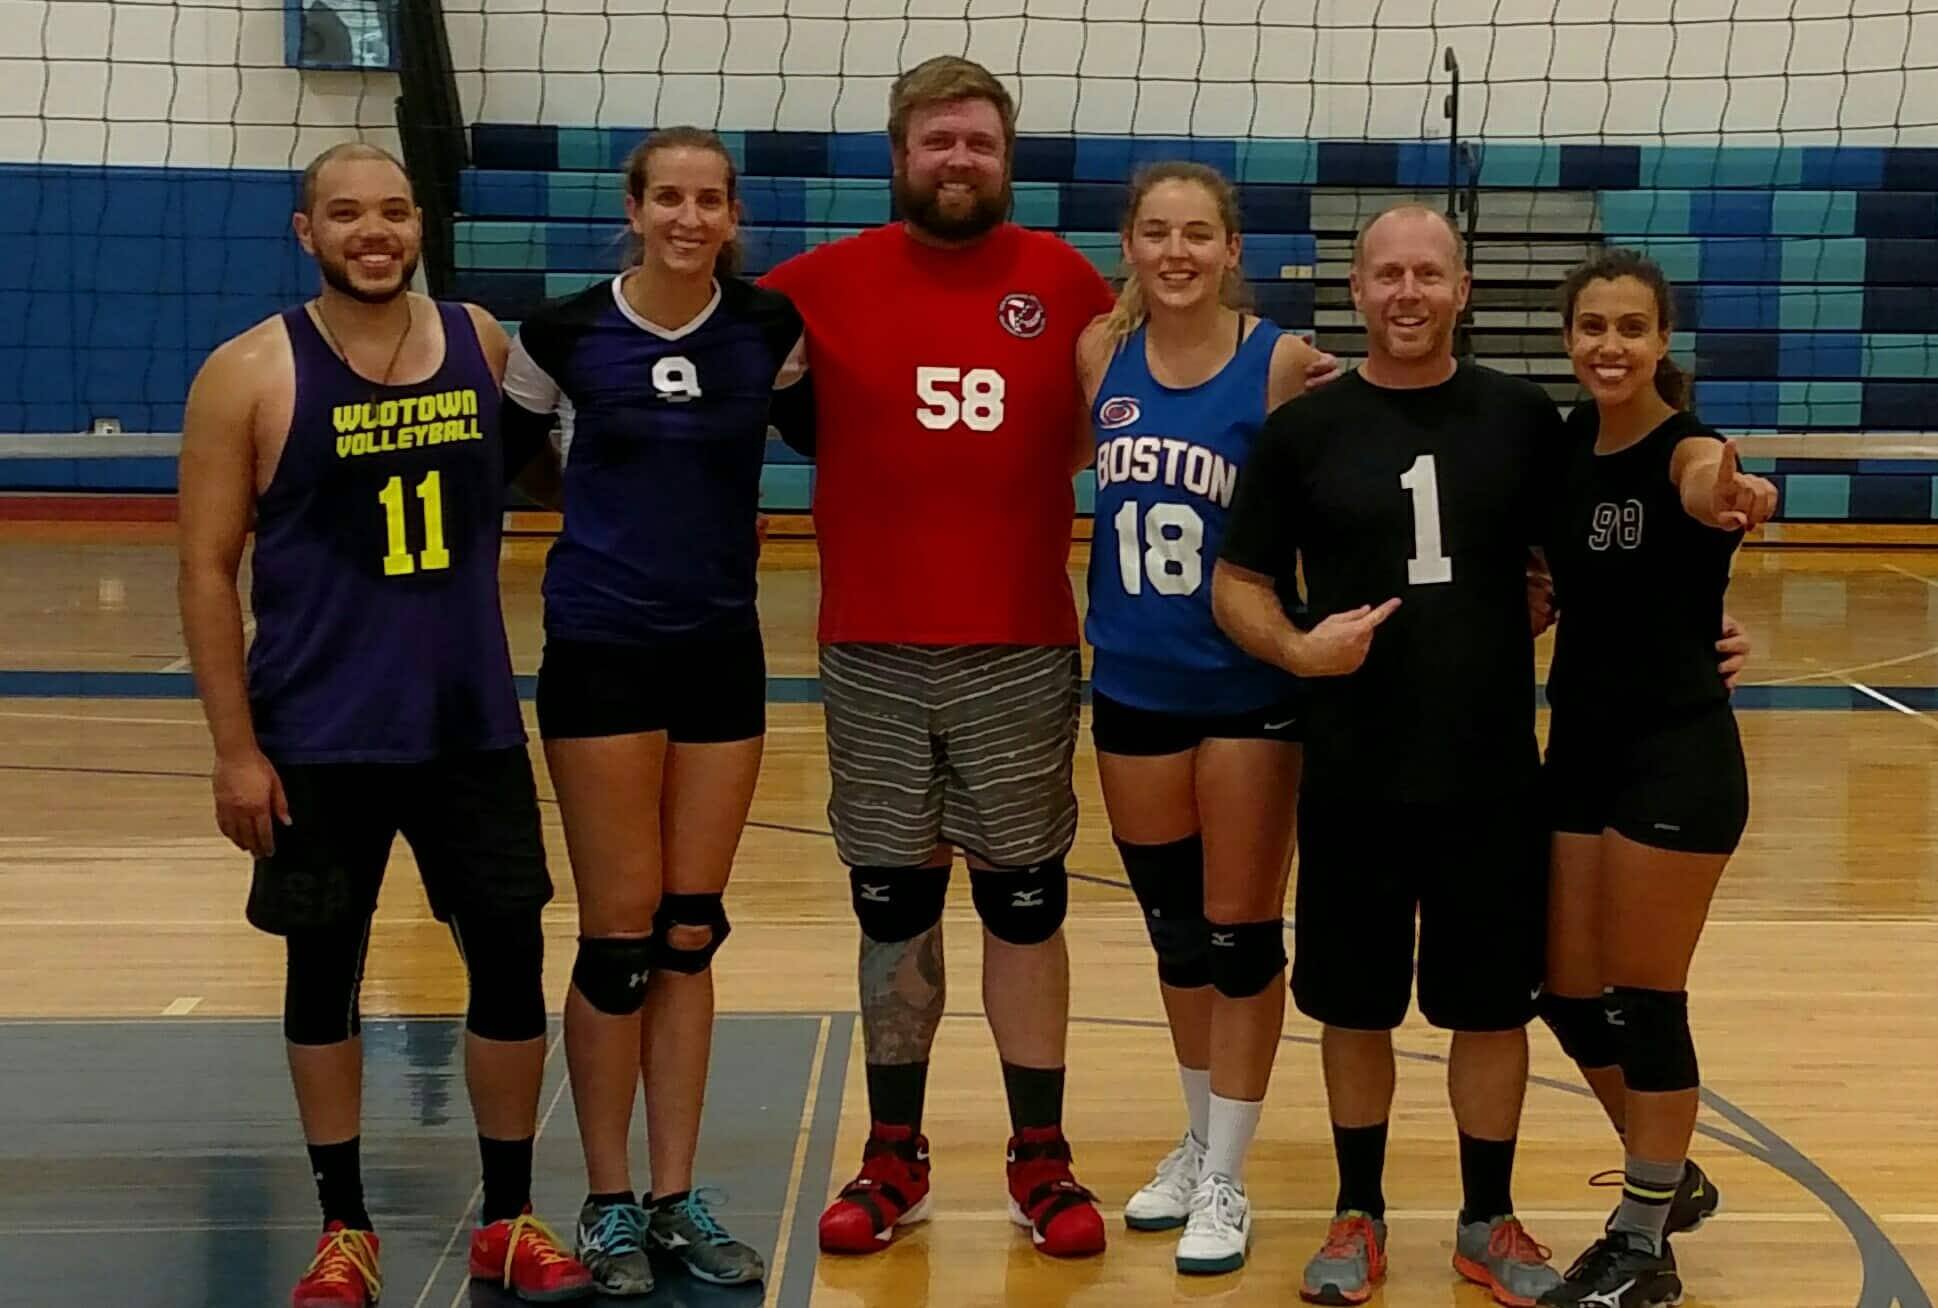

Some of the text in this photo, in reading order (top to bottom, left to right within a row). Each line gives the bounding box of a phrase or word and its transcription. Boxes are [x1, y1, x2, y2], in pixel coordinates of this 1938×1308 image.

[651, 355, 702, 403] 9
[916, 366, 1005, 432] 58
[336, 418, 484, 458] VOLLEYBALL
[1097, 436, 1237, 509] BOSTON
[378, 470, 450, 576] 11
[1114, 500, 1204, 596] 18
[1400, 454, 1453, 585] 1
[1588, 498, 1643, 551] 98
